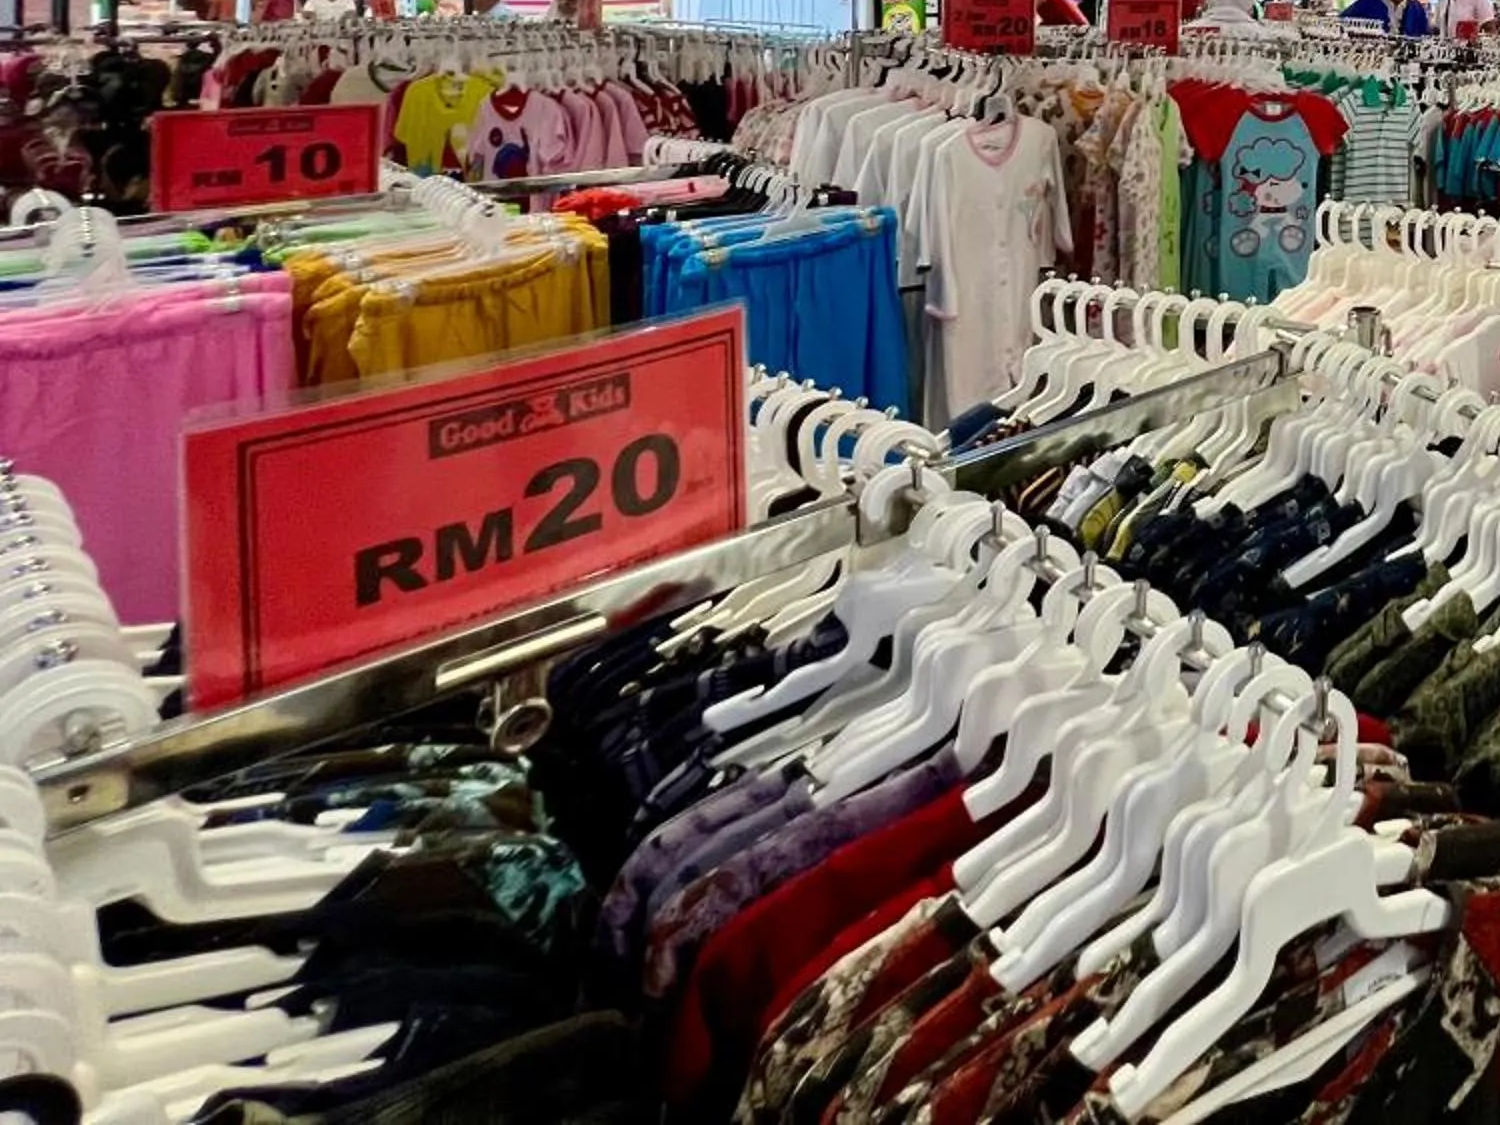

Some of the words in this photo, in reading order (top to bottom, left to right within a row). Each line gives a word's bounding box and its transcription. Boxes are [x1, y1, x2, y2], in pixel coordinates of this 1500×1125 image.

[438, 409, 515, 449] Good
[568, 382, 627, 418] Kids
[355, 433, 682, 607] RM20
